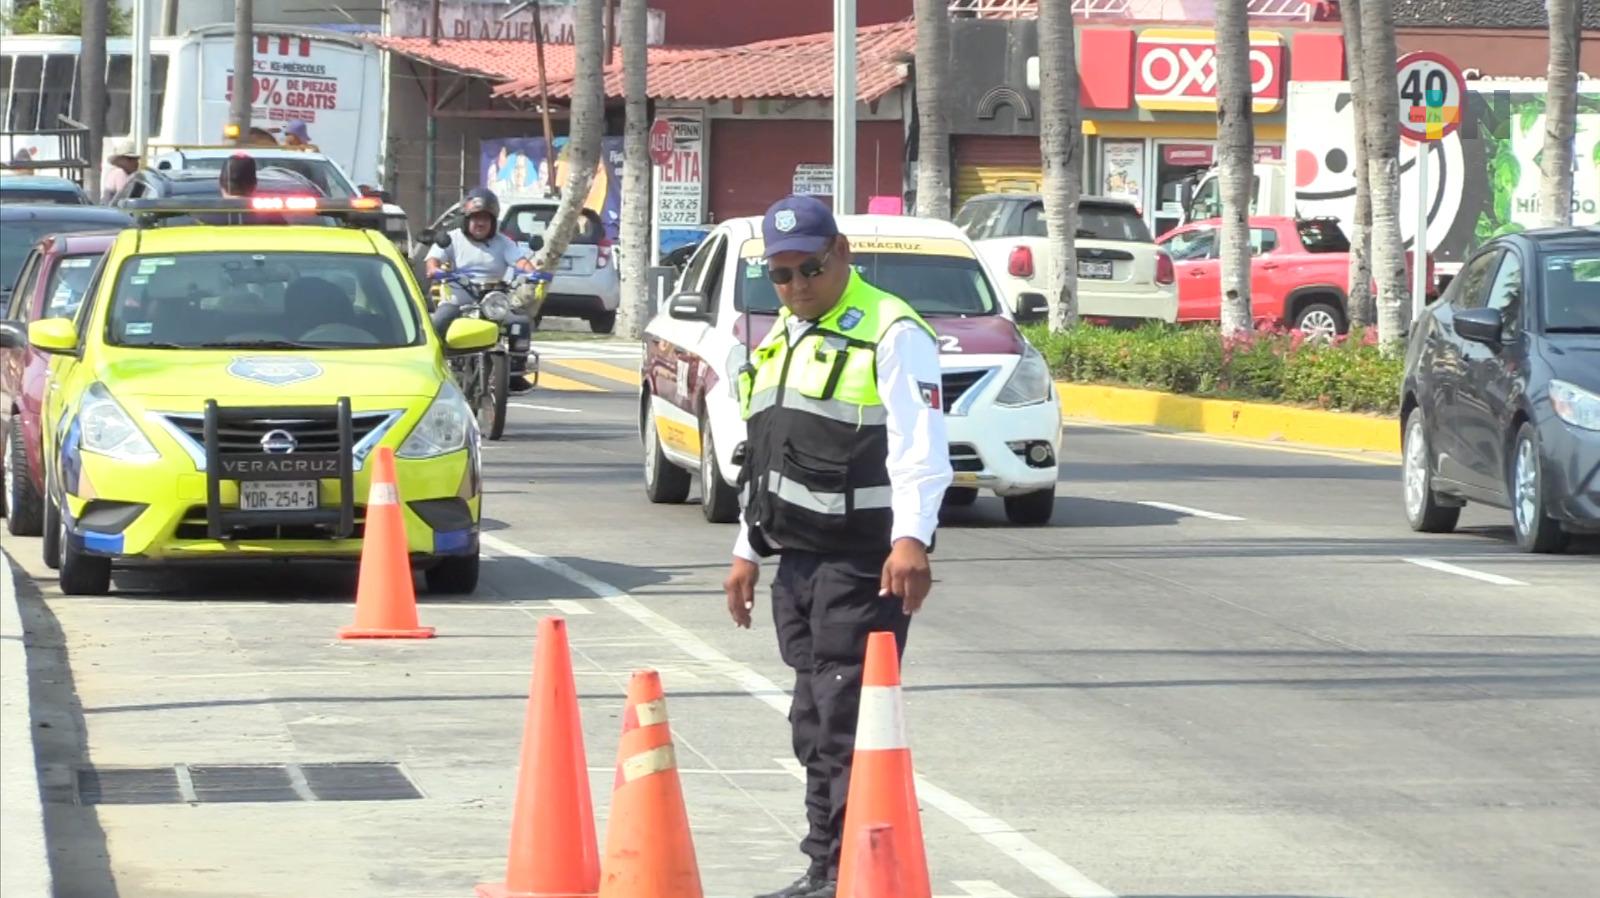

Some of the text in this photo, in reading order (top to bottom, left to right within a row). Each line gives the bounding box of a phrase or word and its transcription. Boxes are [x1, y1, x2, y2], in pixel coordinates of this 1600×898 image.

[1401, 69, 1447, 107] 40
[286, 92, 336, 109] GRATIS
[1408, 111, 1442, 122] km/h
[673, 124, 700, 136] MANN
[651, 134, 673, 152] ALTO
[222, 459, 338, 473] VERACRUZ
